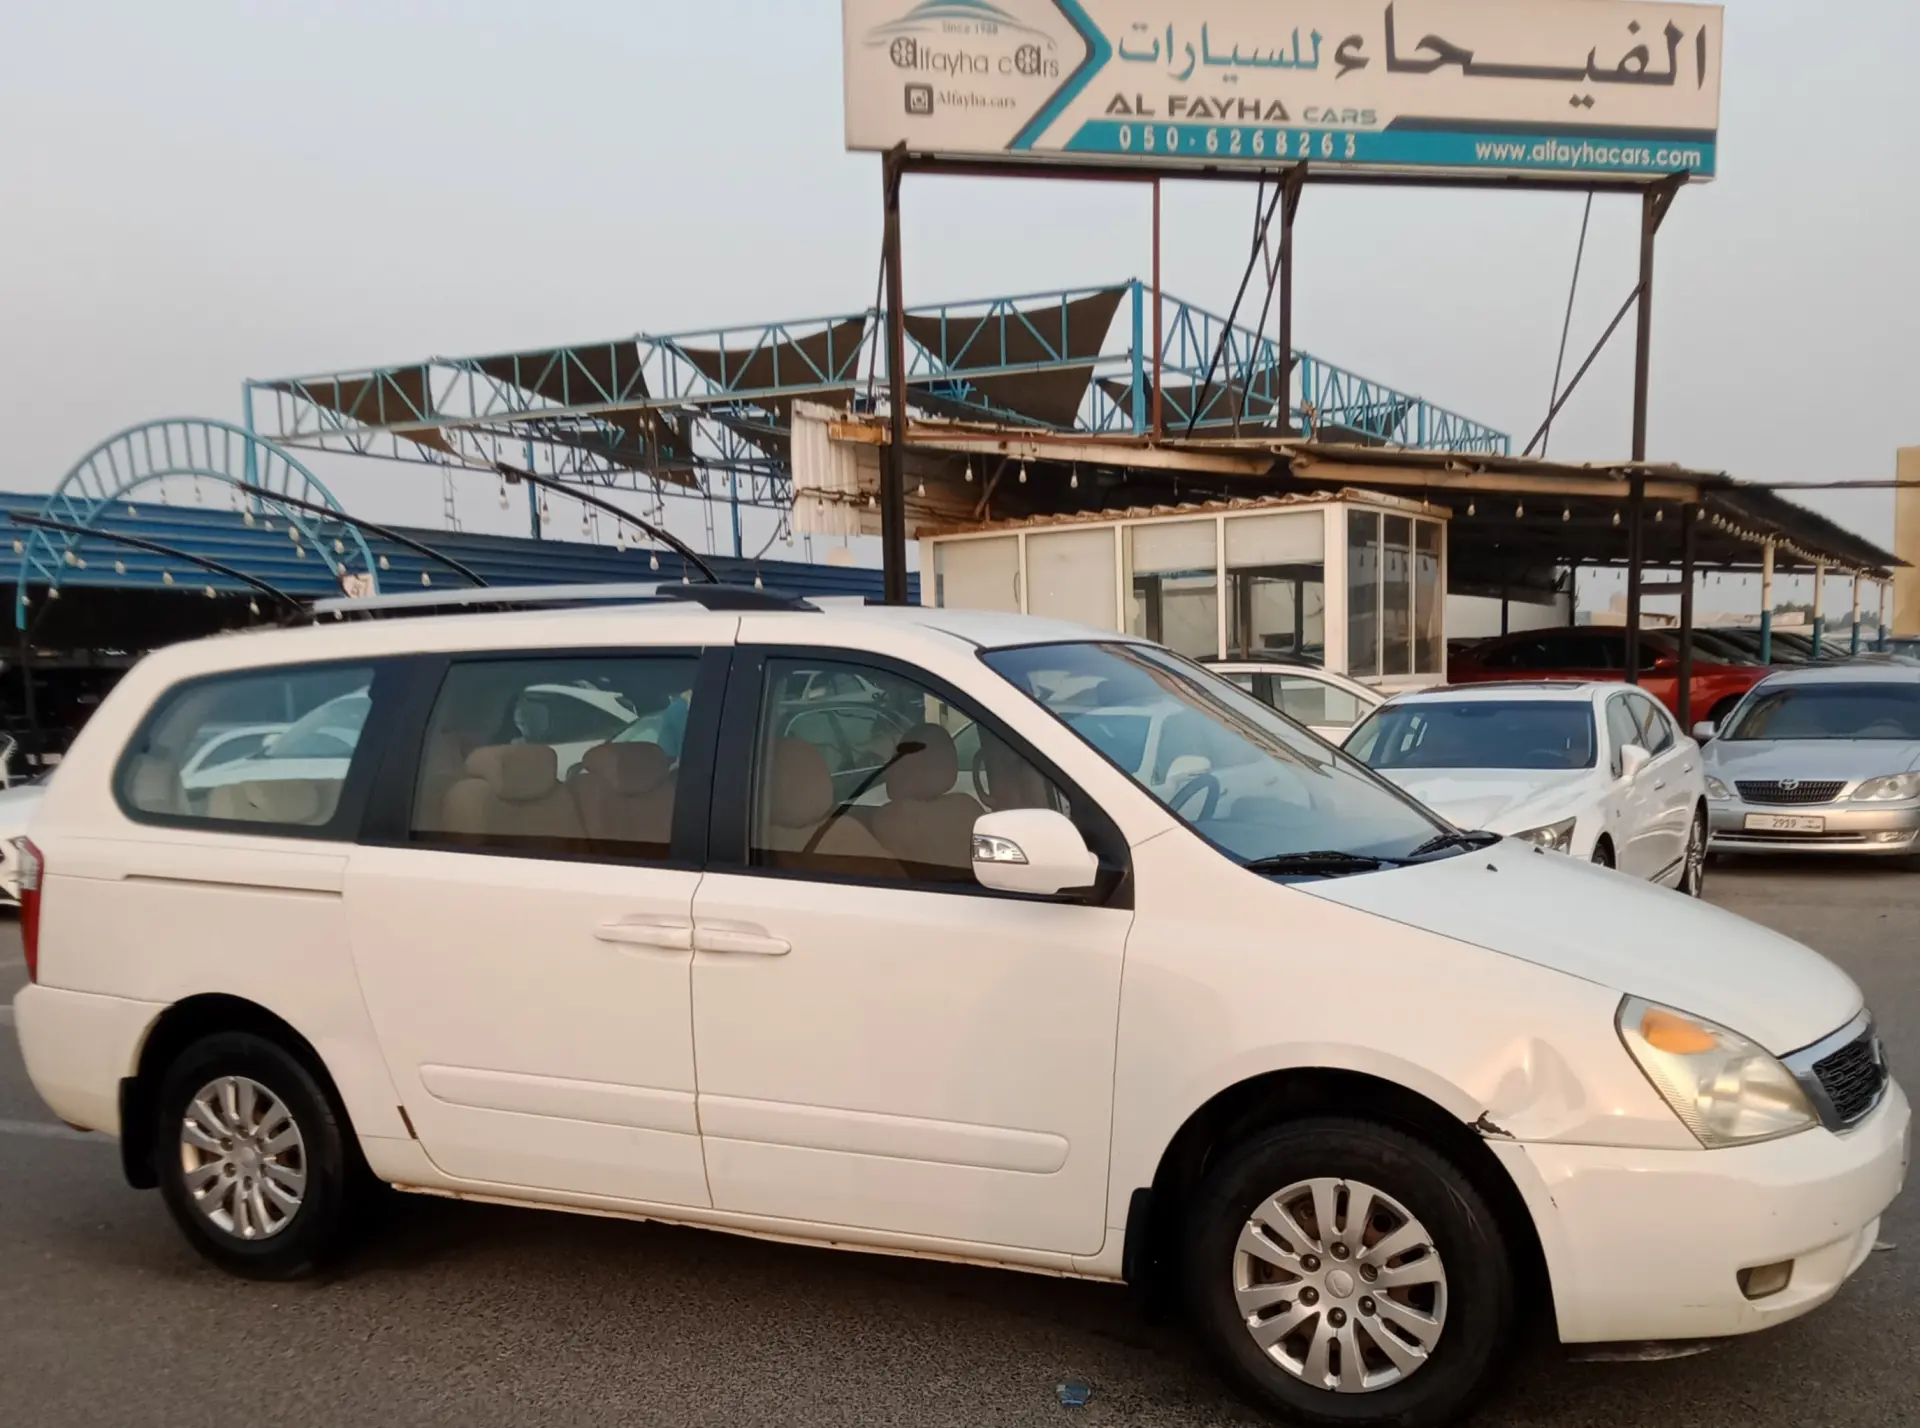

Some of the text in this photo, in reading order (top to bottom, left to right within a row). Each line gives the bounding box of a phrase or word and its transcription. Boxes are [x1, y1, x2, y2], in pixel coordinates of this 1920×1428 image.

[1118, 0, 1707, 109] الفيحاء للسيارات
[1105, 92, 1378, 125] AL FAYHA CARS
[1475, 140, 1701, 167] www.alfayhacars.com
